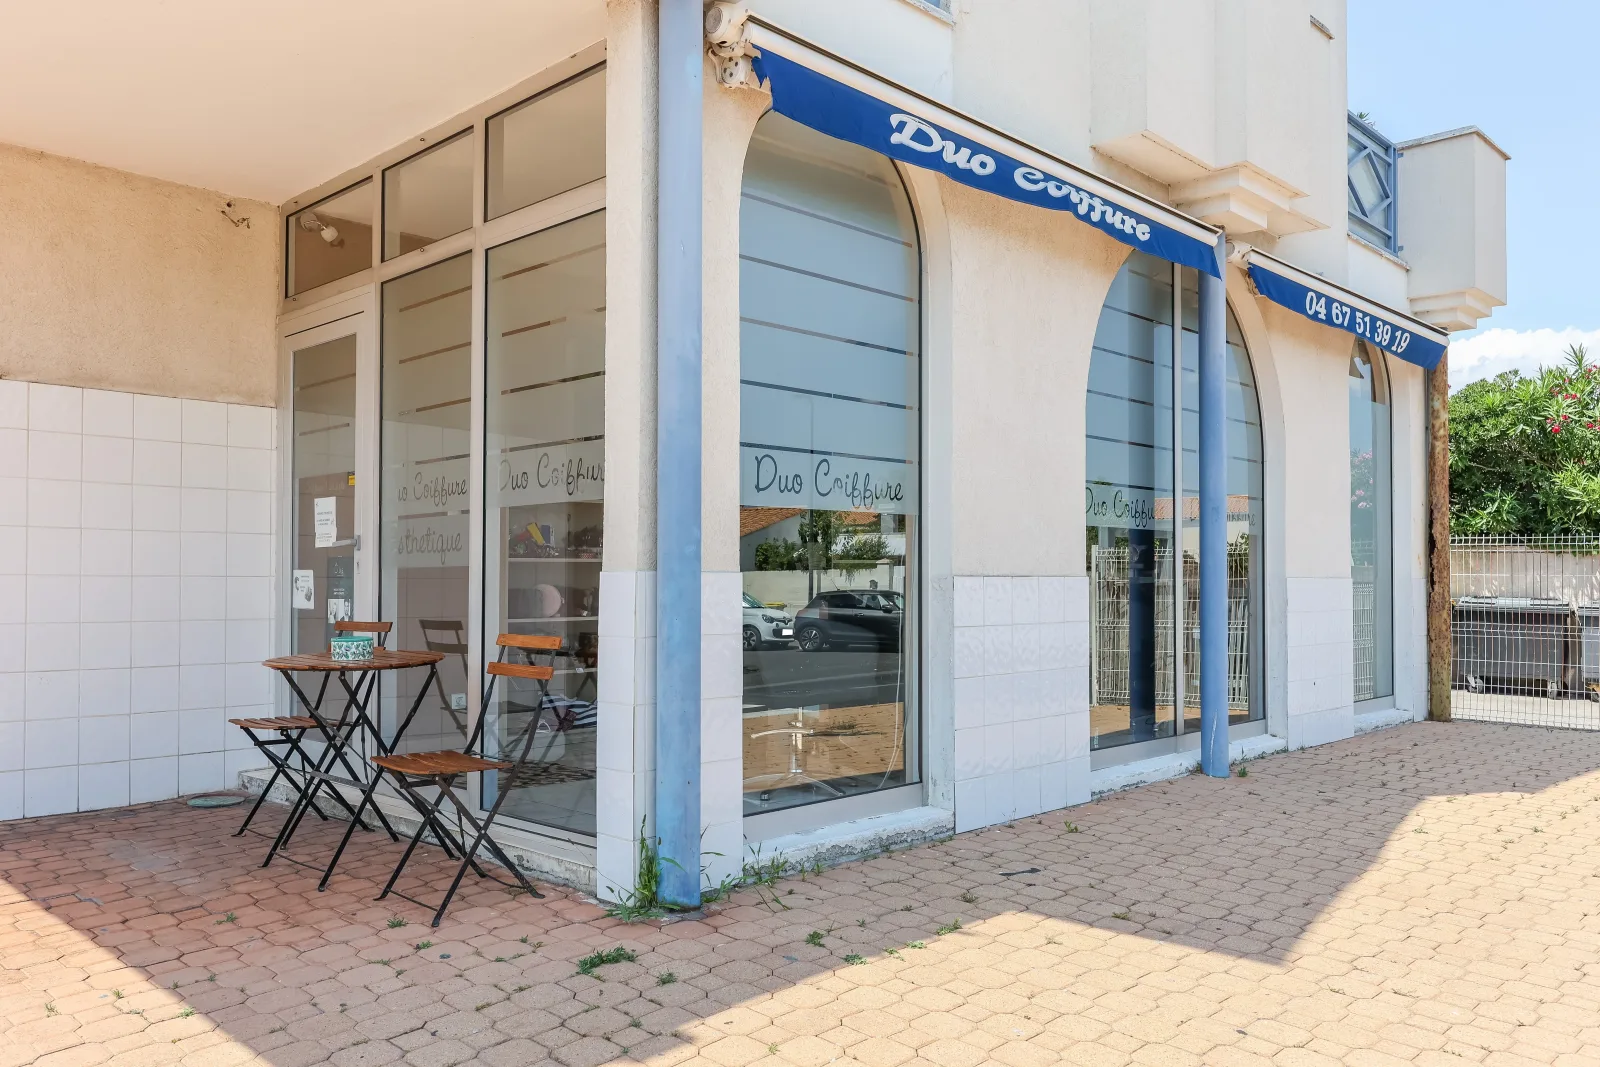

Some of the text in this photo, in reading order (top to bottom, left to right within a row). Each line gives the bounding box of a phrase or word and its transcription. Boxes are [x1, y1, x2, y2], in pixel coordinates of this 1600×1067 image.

[889, 113, 1151, 242] Duo Coiffure
[1305, 291, 1411, 353] 04 67 51 39 19
[413, 471, 468, 507] Coiffure
[537, 452, 605, 497] Coiffur
[754, 454, 904, 511] Duo Coiffure
[397, 526, 463, 565] sthetique
